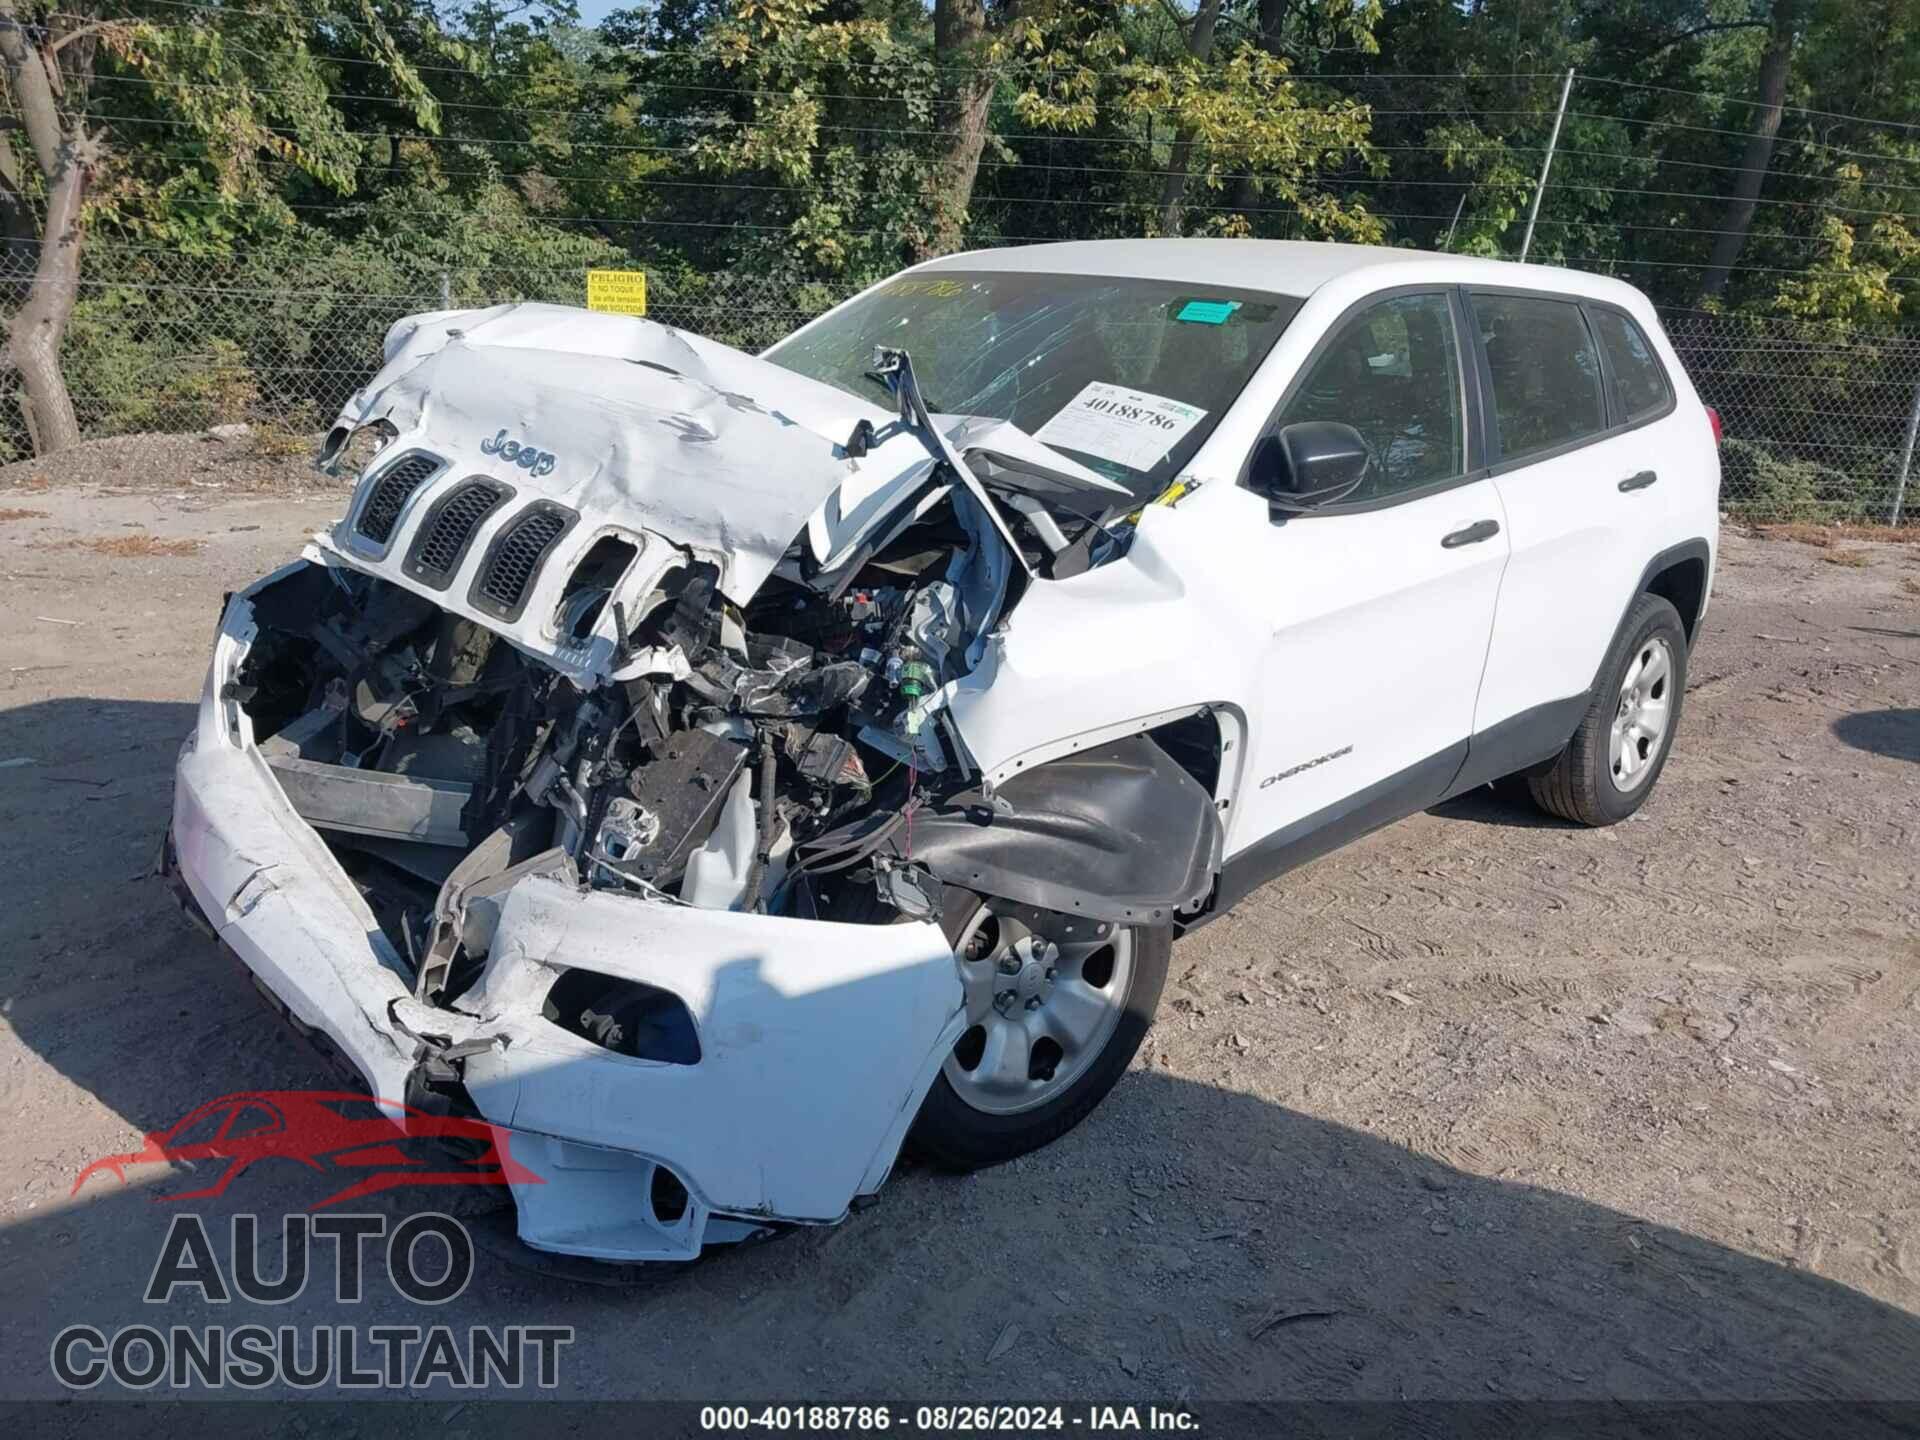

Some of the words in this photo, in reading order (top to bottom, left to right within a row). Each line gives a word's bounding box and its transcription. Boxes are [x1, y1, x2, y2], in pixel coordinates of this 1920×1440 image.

[591, 273, 642, 283] PELIGRO
[1083, 397, 1177, 430] 40188786
[480, 428, 555, 478] Jeep
[1259, 744, 1354, 789] CHEROKEE
